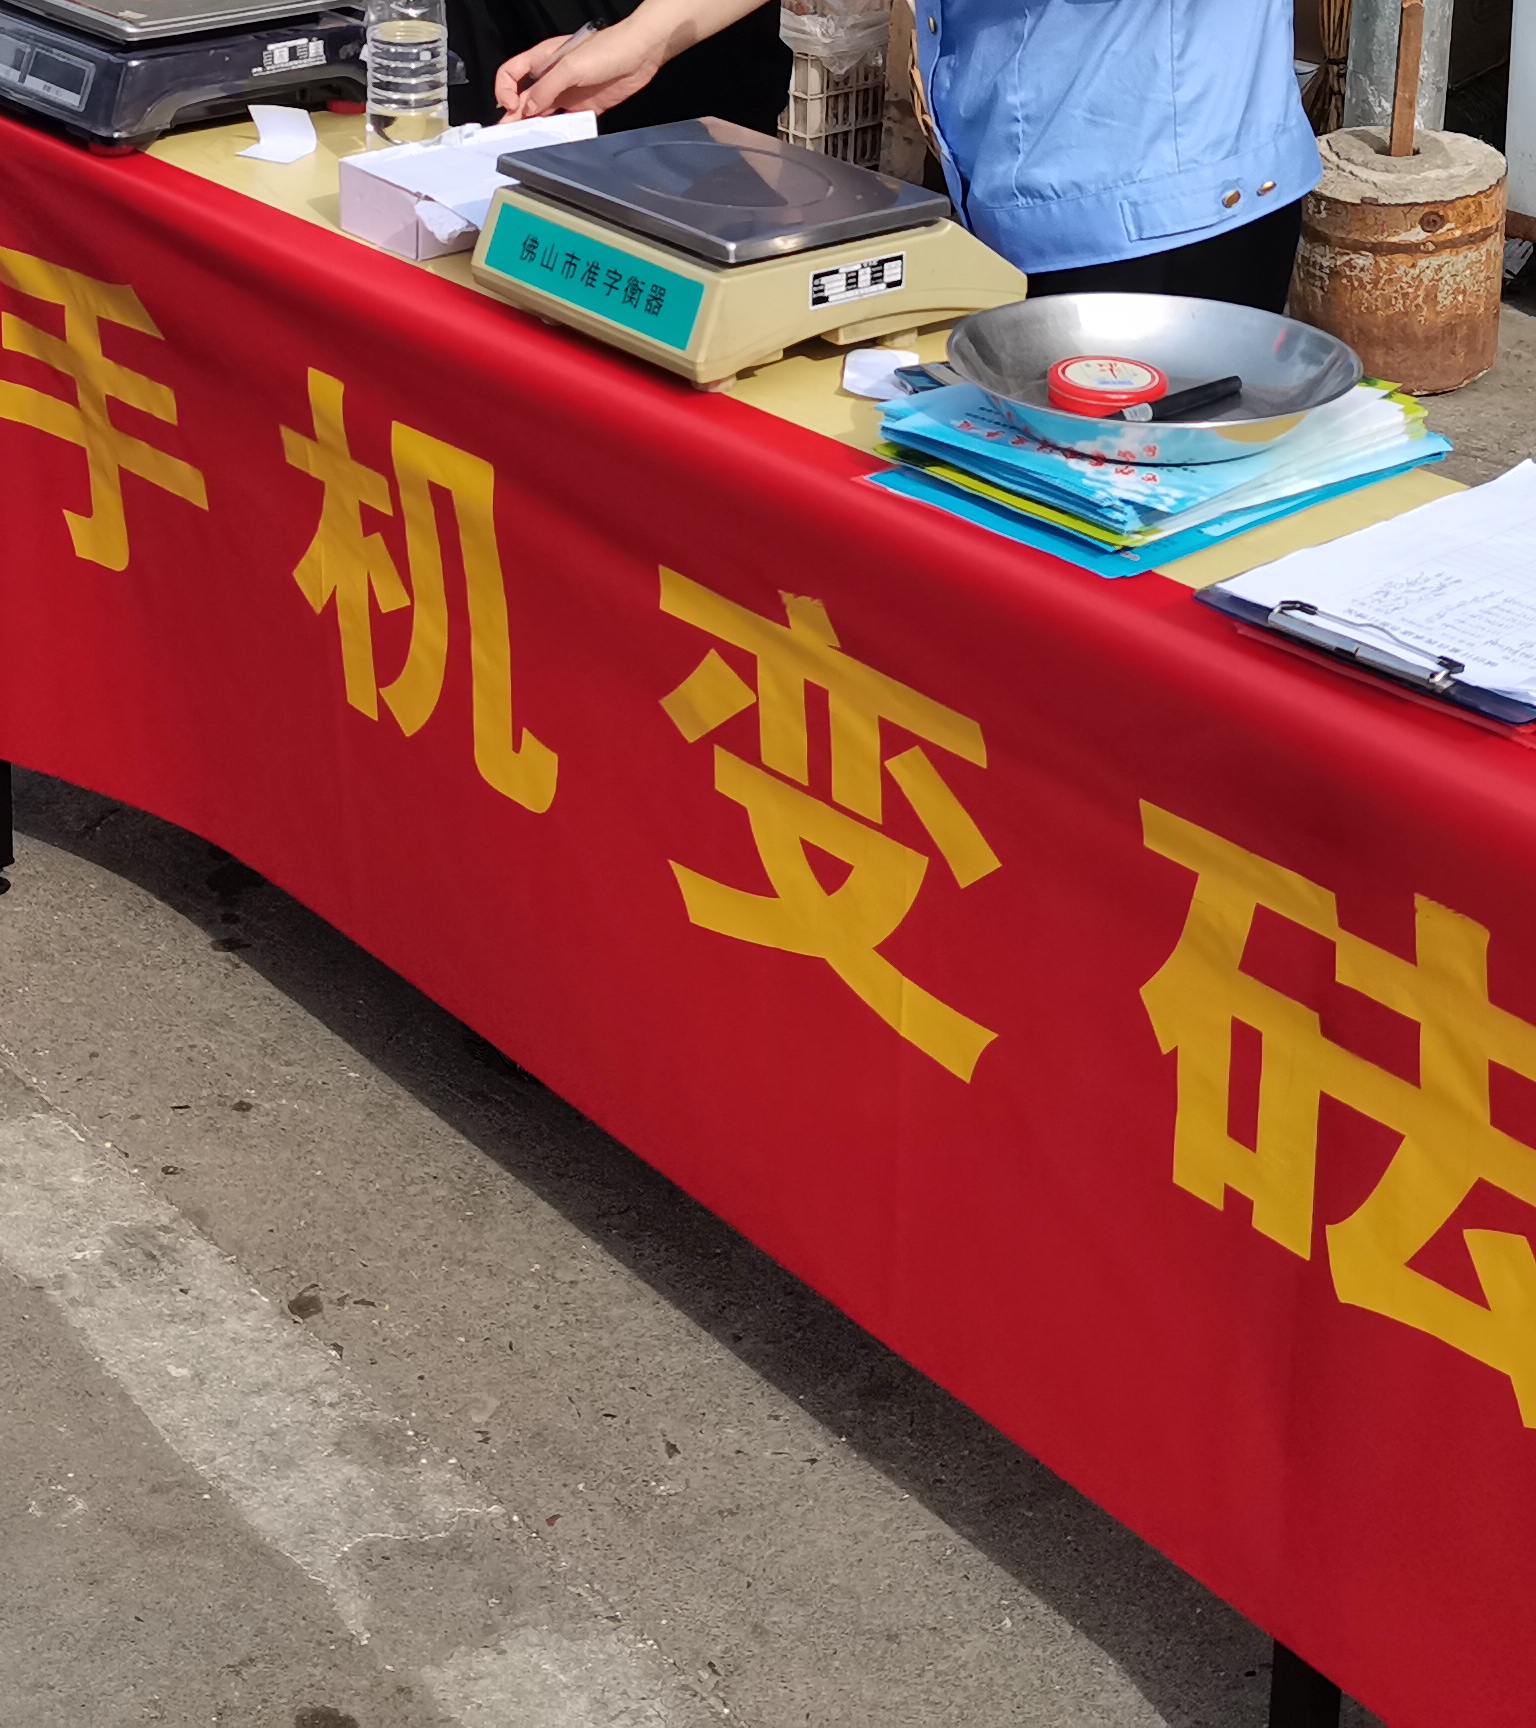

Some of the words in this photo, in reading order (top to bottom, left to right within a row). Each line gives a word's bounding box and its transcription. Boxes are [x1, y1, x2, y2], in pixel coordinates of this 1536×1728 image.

[518, 233, 668, 317] 佛山市准字衡器
